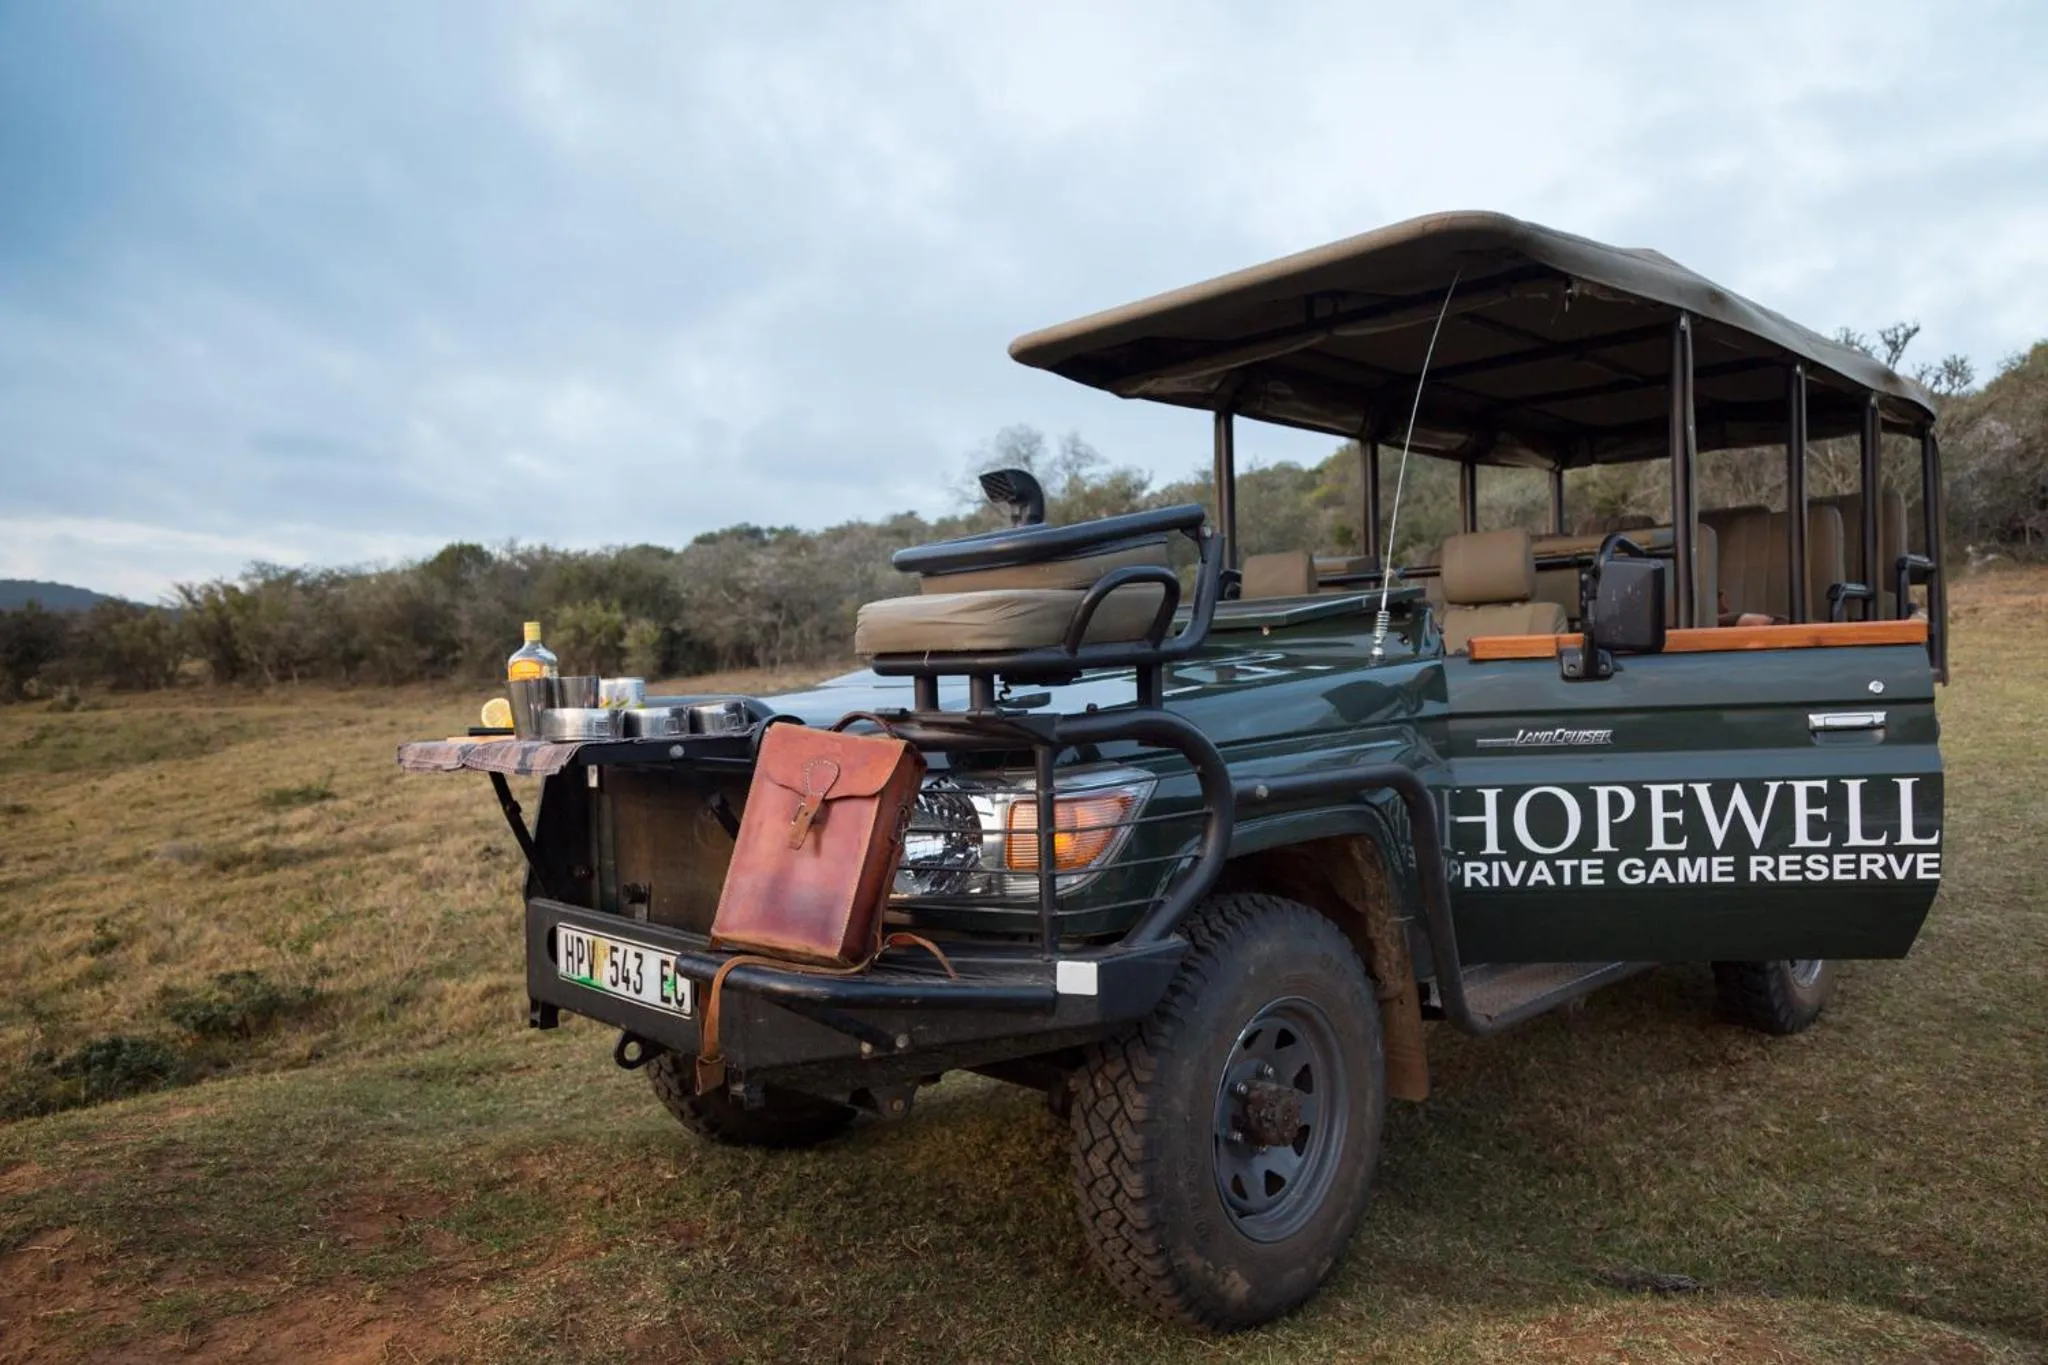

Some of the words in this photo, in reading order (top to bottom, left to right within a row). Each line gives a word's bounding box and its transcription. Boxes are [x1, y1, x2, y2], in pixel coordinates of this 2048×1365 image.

[1455, 778, 1939, 855] HOPEWELL
[1456, 858, 1605, 888] RIVATE
[1617, 855, 1735, 885] GAME
[1749, 852, 1941, 883] RESERVE
[565, 933, 596, 980] HPV
[609, 945, 643, 994] 543
